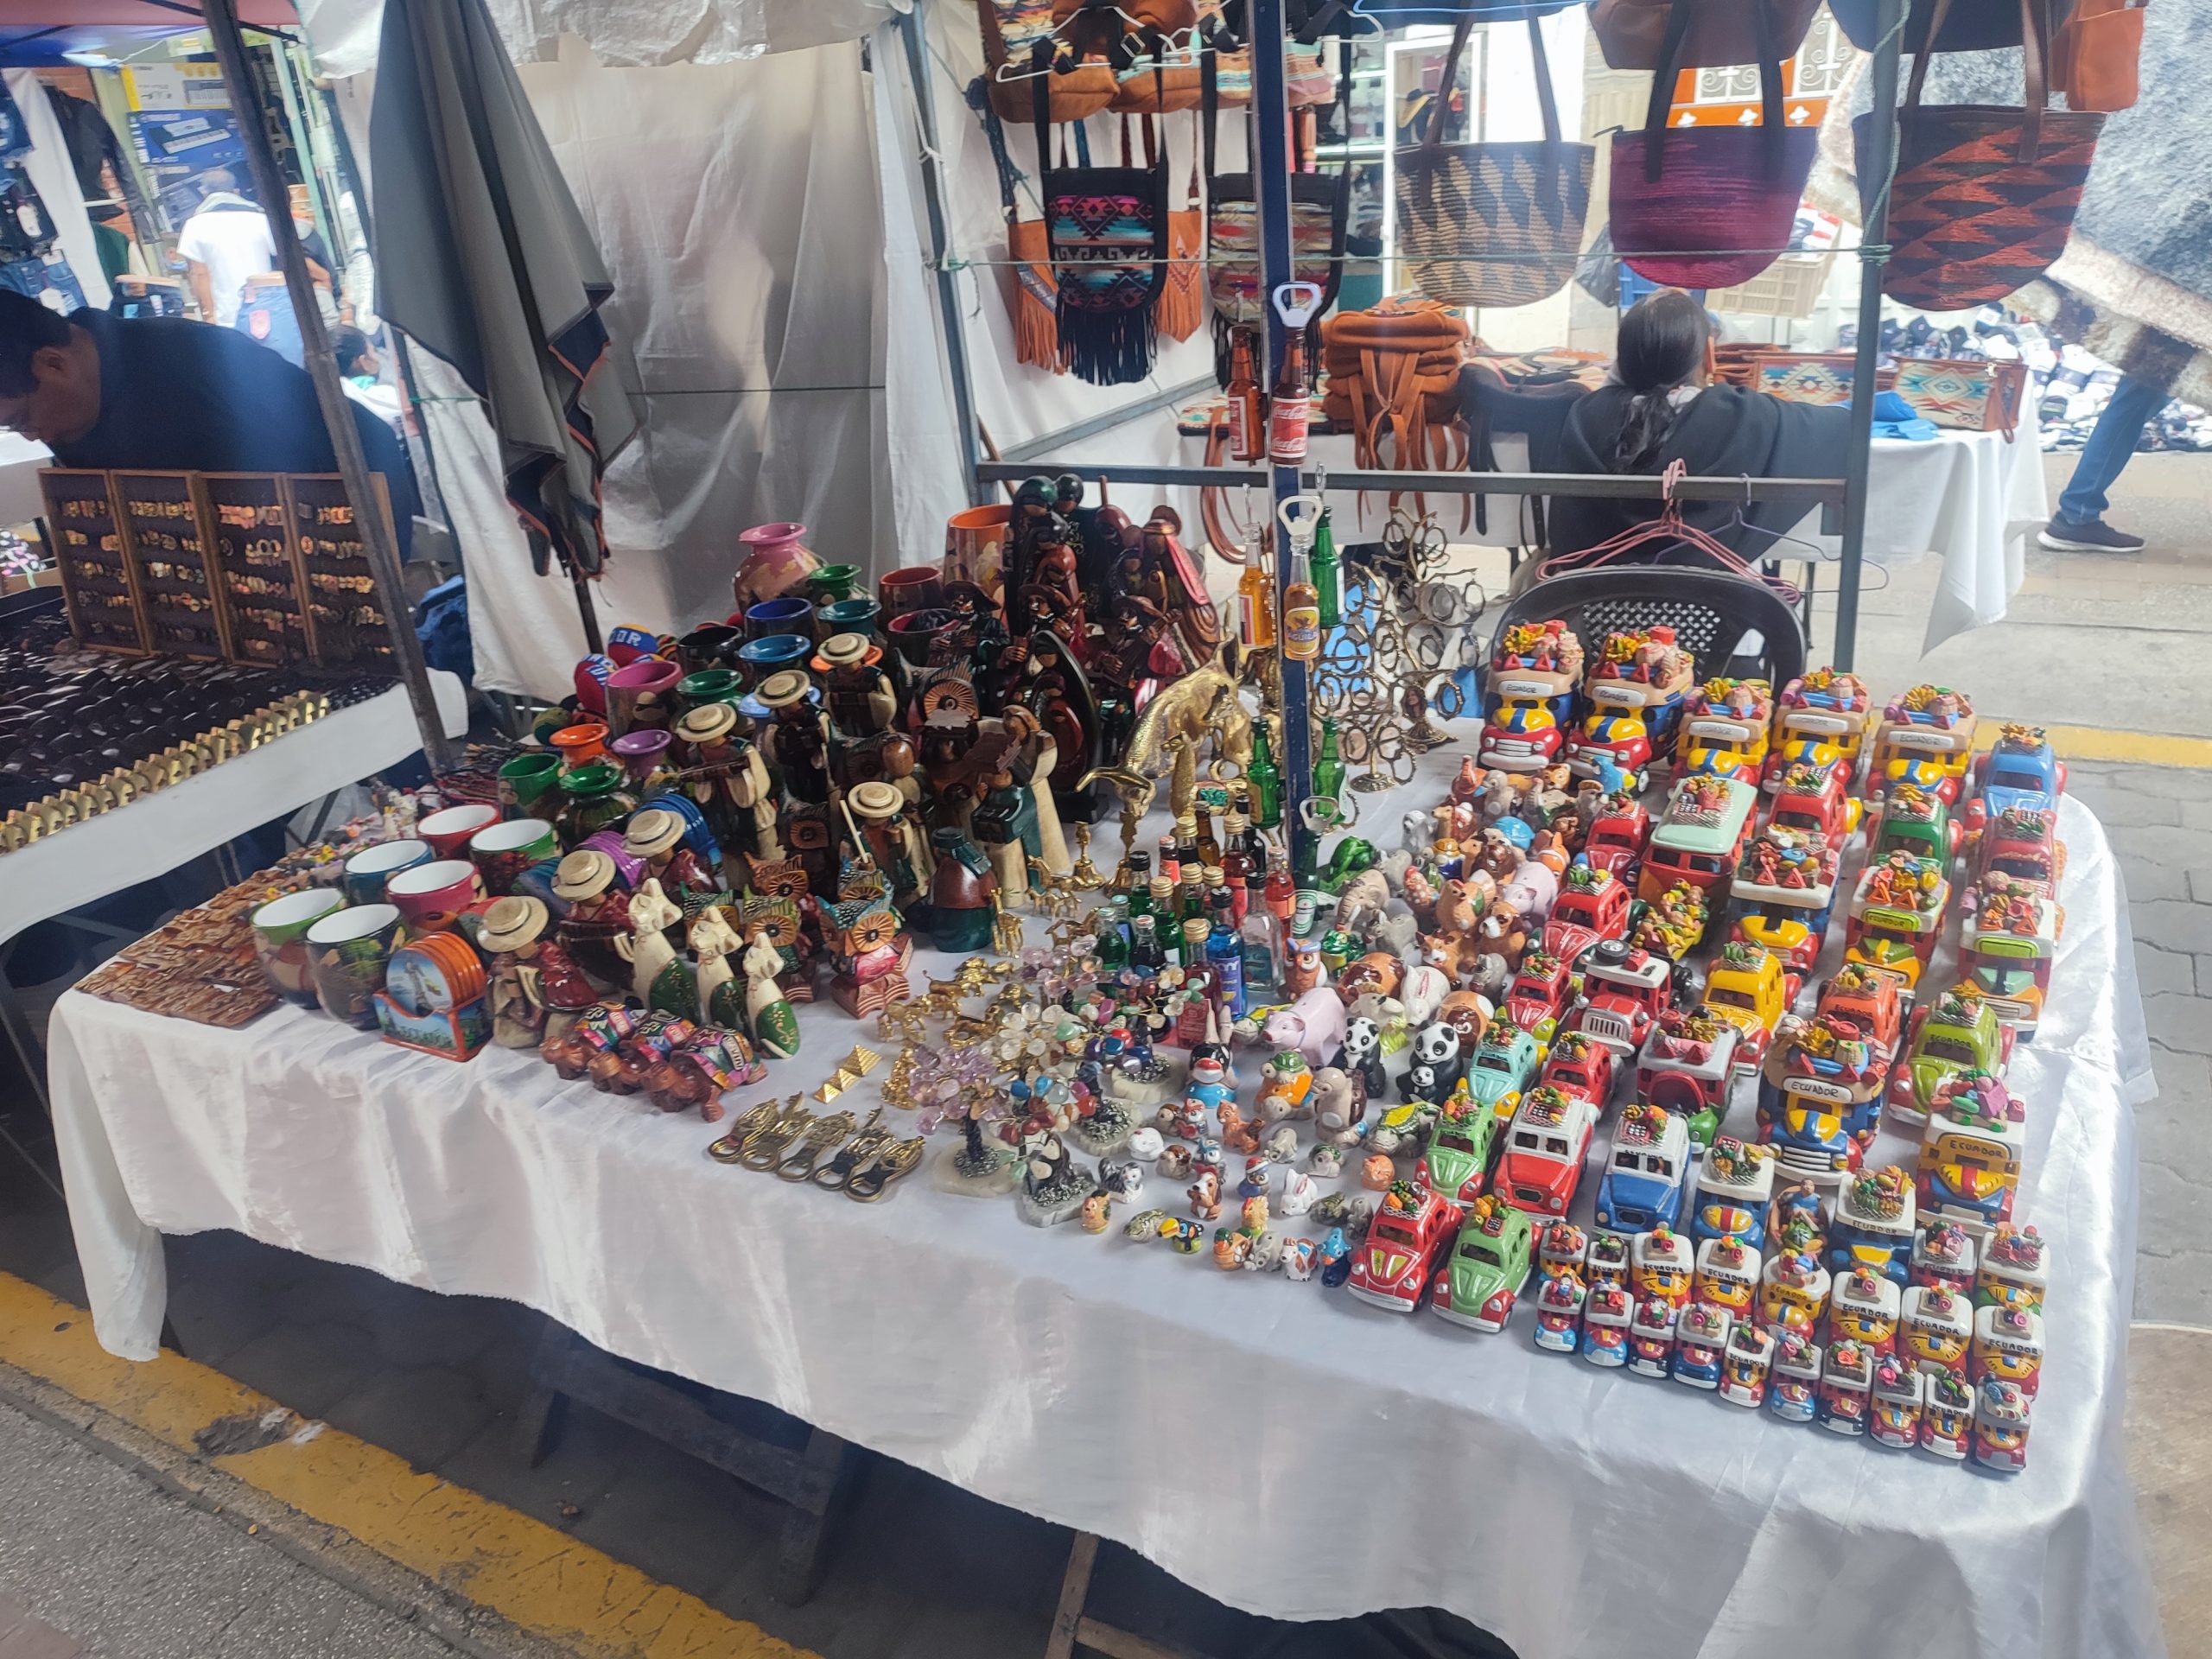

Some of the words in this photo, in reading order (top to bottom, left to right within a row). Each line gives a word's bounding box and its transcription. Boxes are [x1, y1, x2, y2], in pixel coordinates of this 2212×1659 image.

[1834, 1004, 1872, 1017] ECUADOR
[1931, 1034, 1972, 1047] ECUADOR
[1791, 1082, 1839, 1097] ECUADOR
[1949, 1140, 2005, 1158] ECUADOR
[1853, 1221, 1897, 1235] ECUADOR
[1643, 1263, 1684, 1273] ECUADOR
[1707, 1268, 1750, 1283] ECUADOR
[1843, 1304, 1890, 1319] ECUADOR
[1913, 1320, 1960, 1335] ECUADOR
[1989, 1340, 2038, 1355] ECUADOR
[1729, 1353, 1765, 1366] ECUADOR
